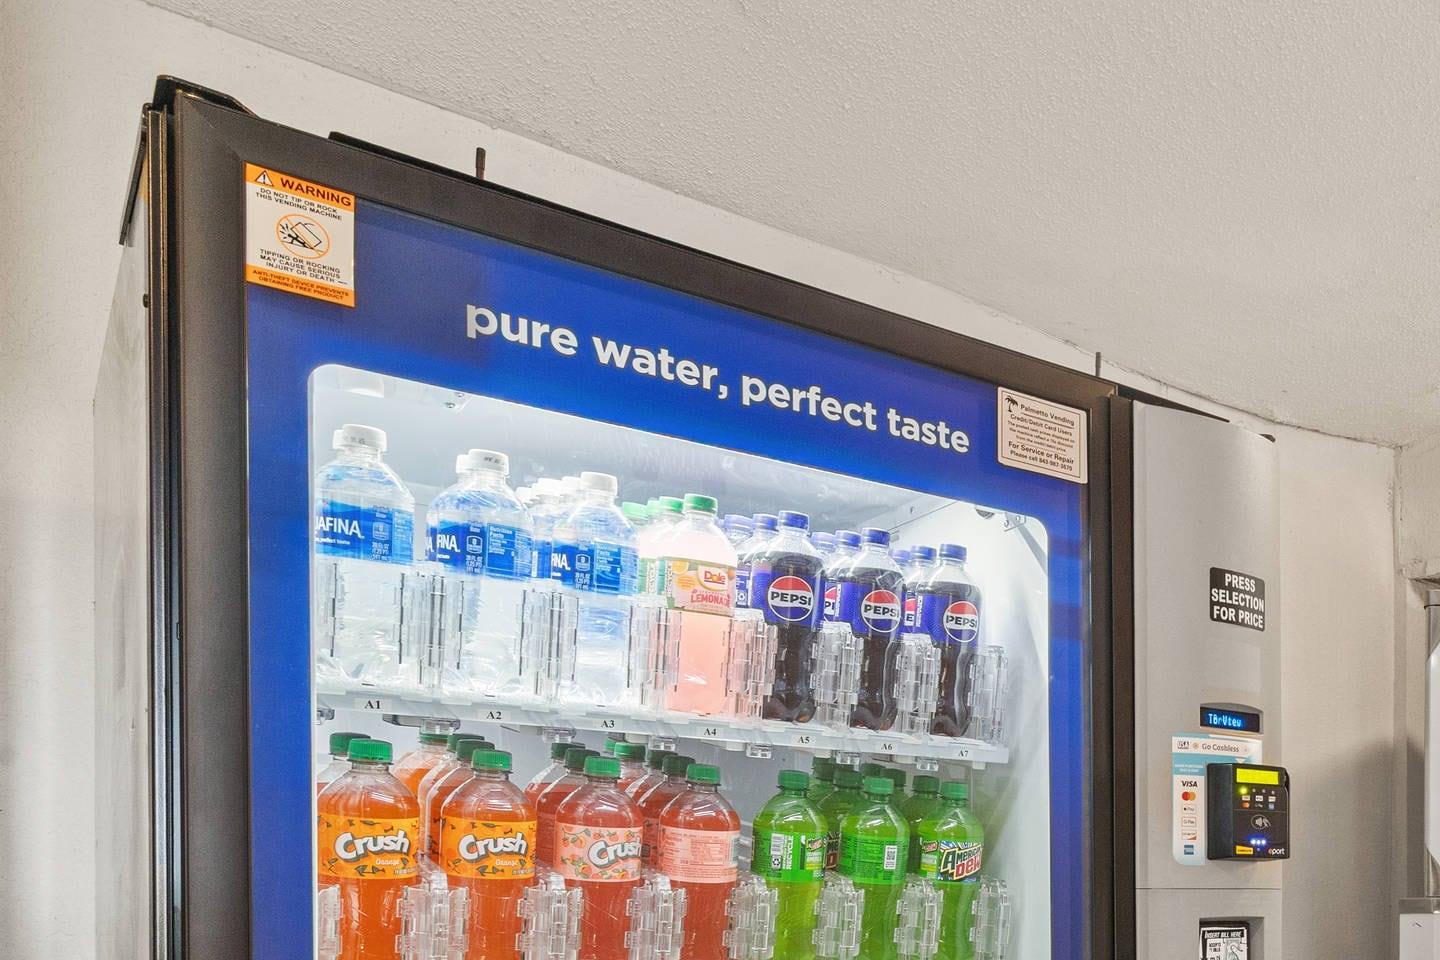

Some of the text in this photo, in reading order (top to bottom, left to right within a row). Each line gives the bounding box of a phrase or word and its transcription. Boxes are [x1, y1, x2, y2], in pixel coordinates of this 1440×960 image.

[273, 191, 288, 200] NOT
[316, 203, 338, 214] ROCK
[281, 178, 352, 206] WARNING
[256, 192, 342, 220] THIS VENDING MACHINE
[260, 249, 290, 260] TIPPING
[306, 260, 341, 274] ROCKING
[260, 254, 340, 278] MAY CAUSE SERIOUS
[266, 262, 294, 272] INJURY
[310, 272, 335, 282] DEATH
[314, 289, 344, 300] PRODUCT
[316, 284, 349, 296] PREVENTS
[466, 304, 578, 356] pure
[592, 335, 728, 399] water,
[742, 374, 877, 431] perfect
[888, 408, 970, 454] taste
[1010, 414, 1044, 428] Credit/Debit
[1058, 428, 1072, 436] Users
[1020, 404, 1074, 426] Palmetto Vending
[1008, 440, 1018, 450] For
[1020, 444, 1044, 457] Service
[1054, 453, 1074, 465] Repair
[1010, 450, 1028, 460] Please
[704, 571, 726, 582] Dole
[1225, 573, 1255, 593] PRESS
[770, 590, 812, 606] PEPSI
[1211, 588, 1264, 612] SELECTION
[1214, 606, 1263, 629] FOR PRICE
[364, 700, 381, 710] A1
[486, 711, 502, 720] A2
[601, 720, 615, 729] A3
[704, 728, 717, 736] A4
[1213, 744, 1240, 752] Cashless
[334, 832, 410, 861] Crush
[458, 832, 528, 862] Crush
